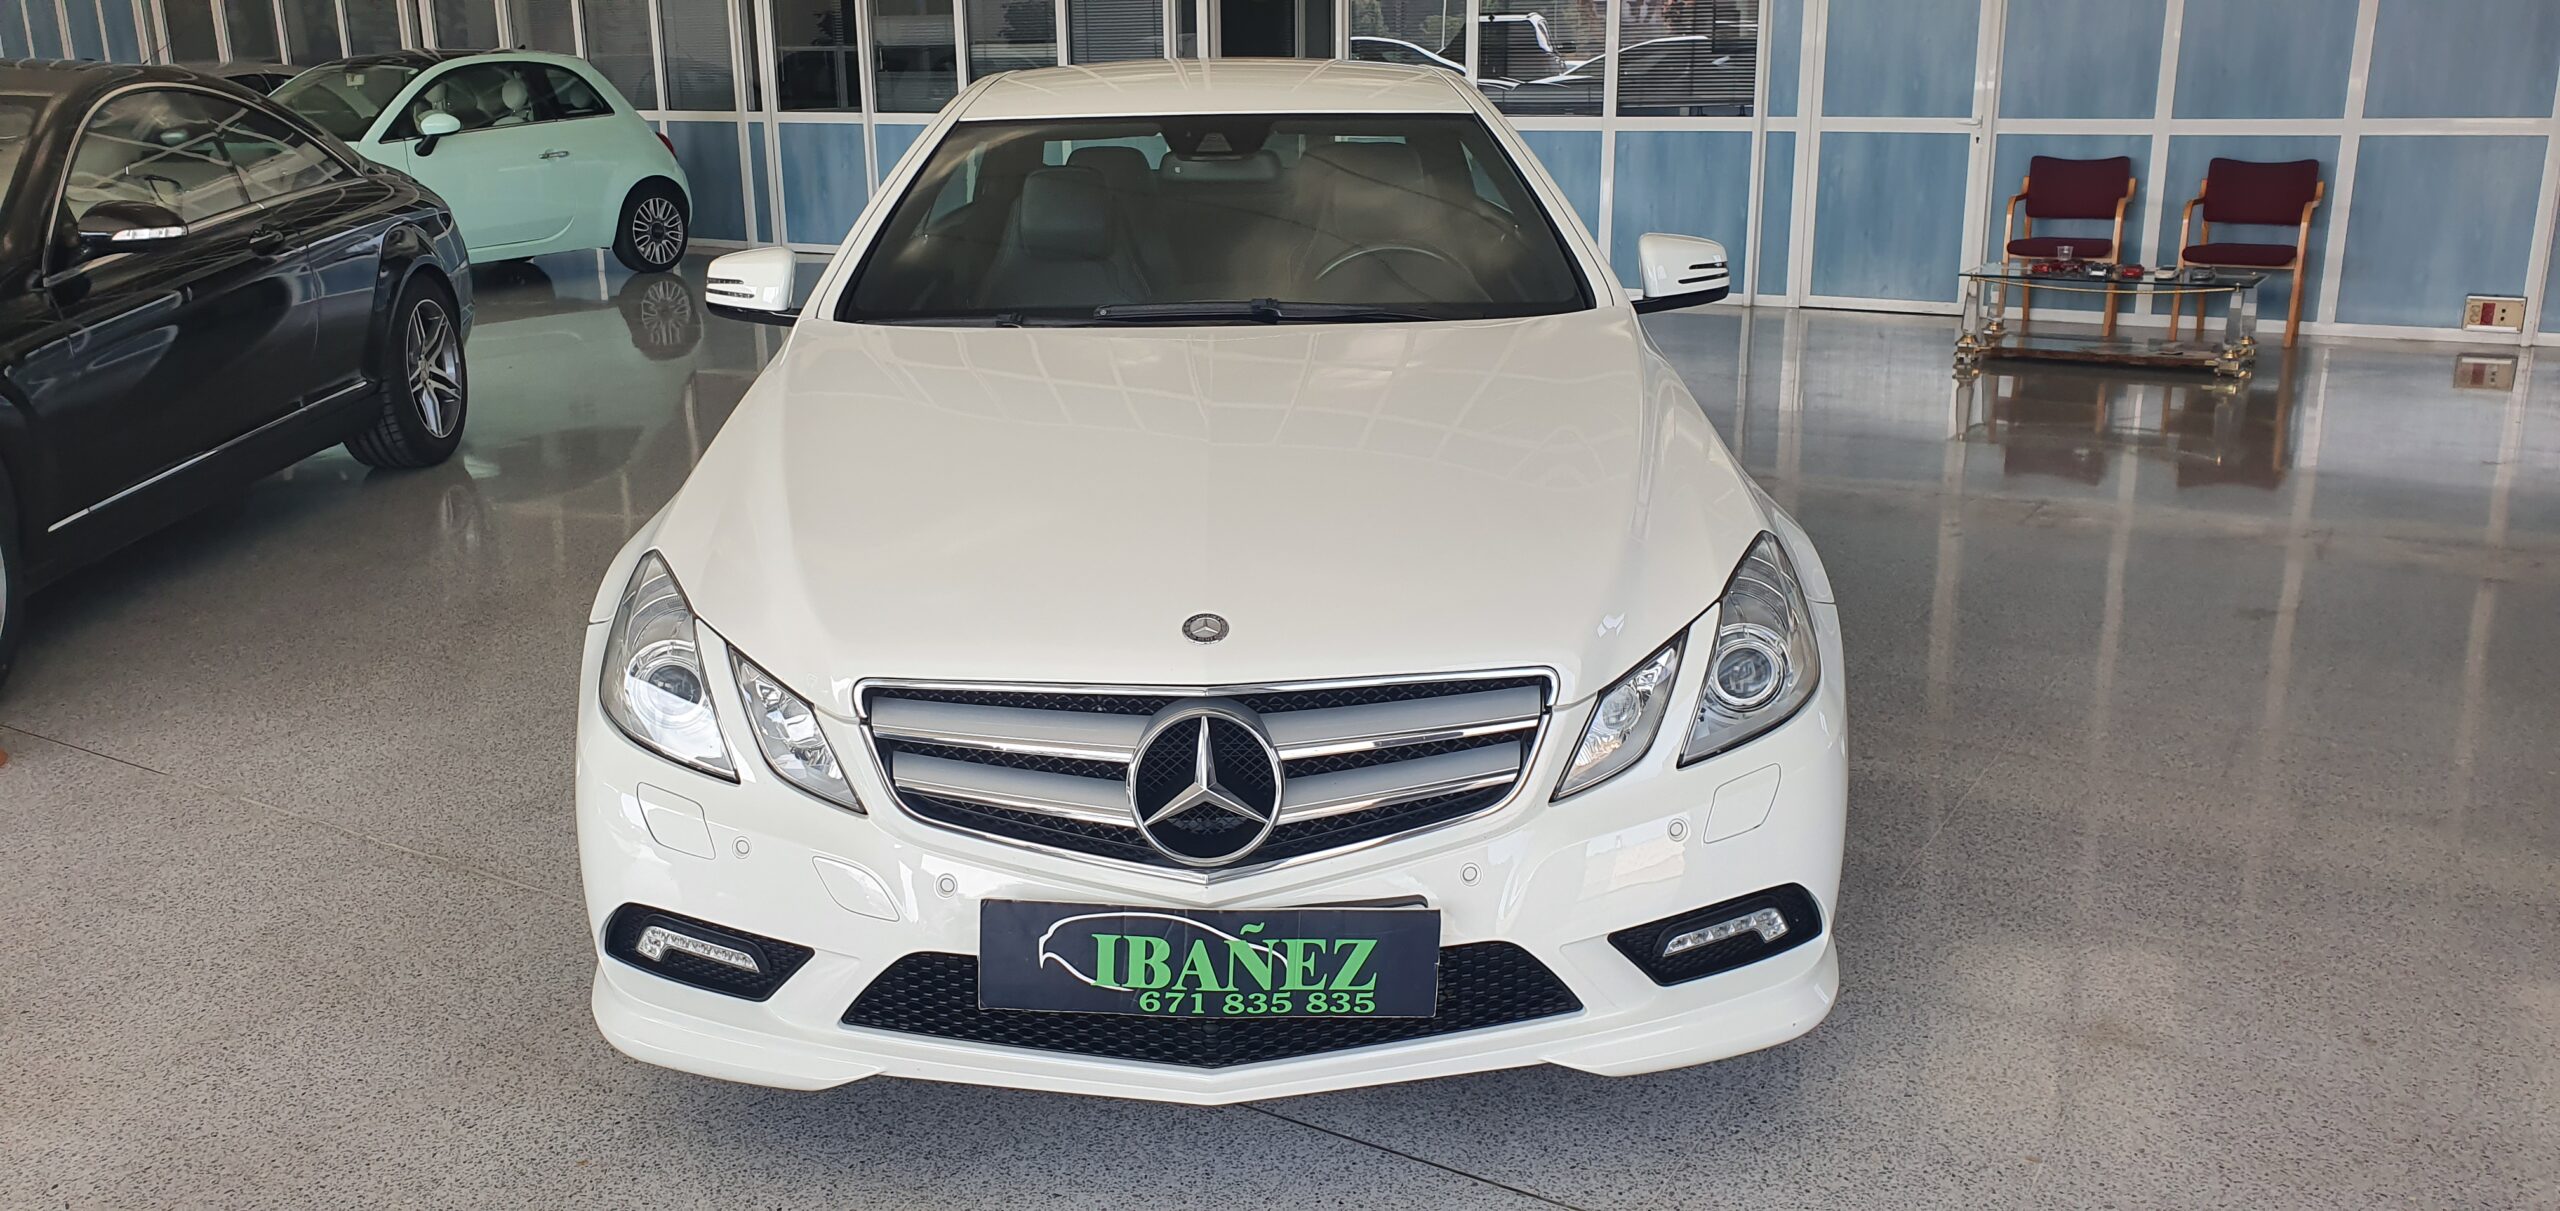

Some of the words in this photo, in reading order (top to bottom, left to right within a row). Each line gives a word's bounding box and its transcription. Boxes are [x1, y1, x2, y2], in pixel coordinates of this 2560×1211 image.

[1091, 922, 1378, 992] IBAÑEZ
[1139, 991, 1206, 1014] 671
[1222, 992, 1293, 1014] 835
[1305, 991, 1376, 1014] 835
